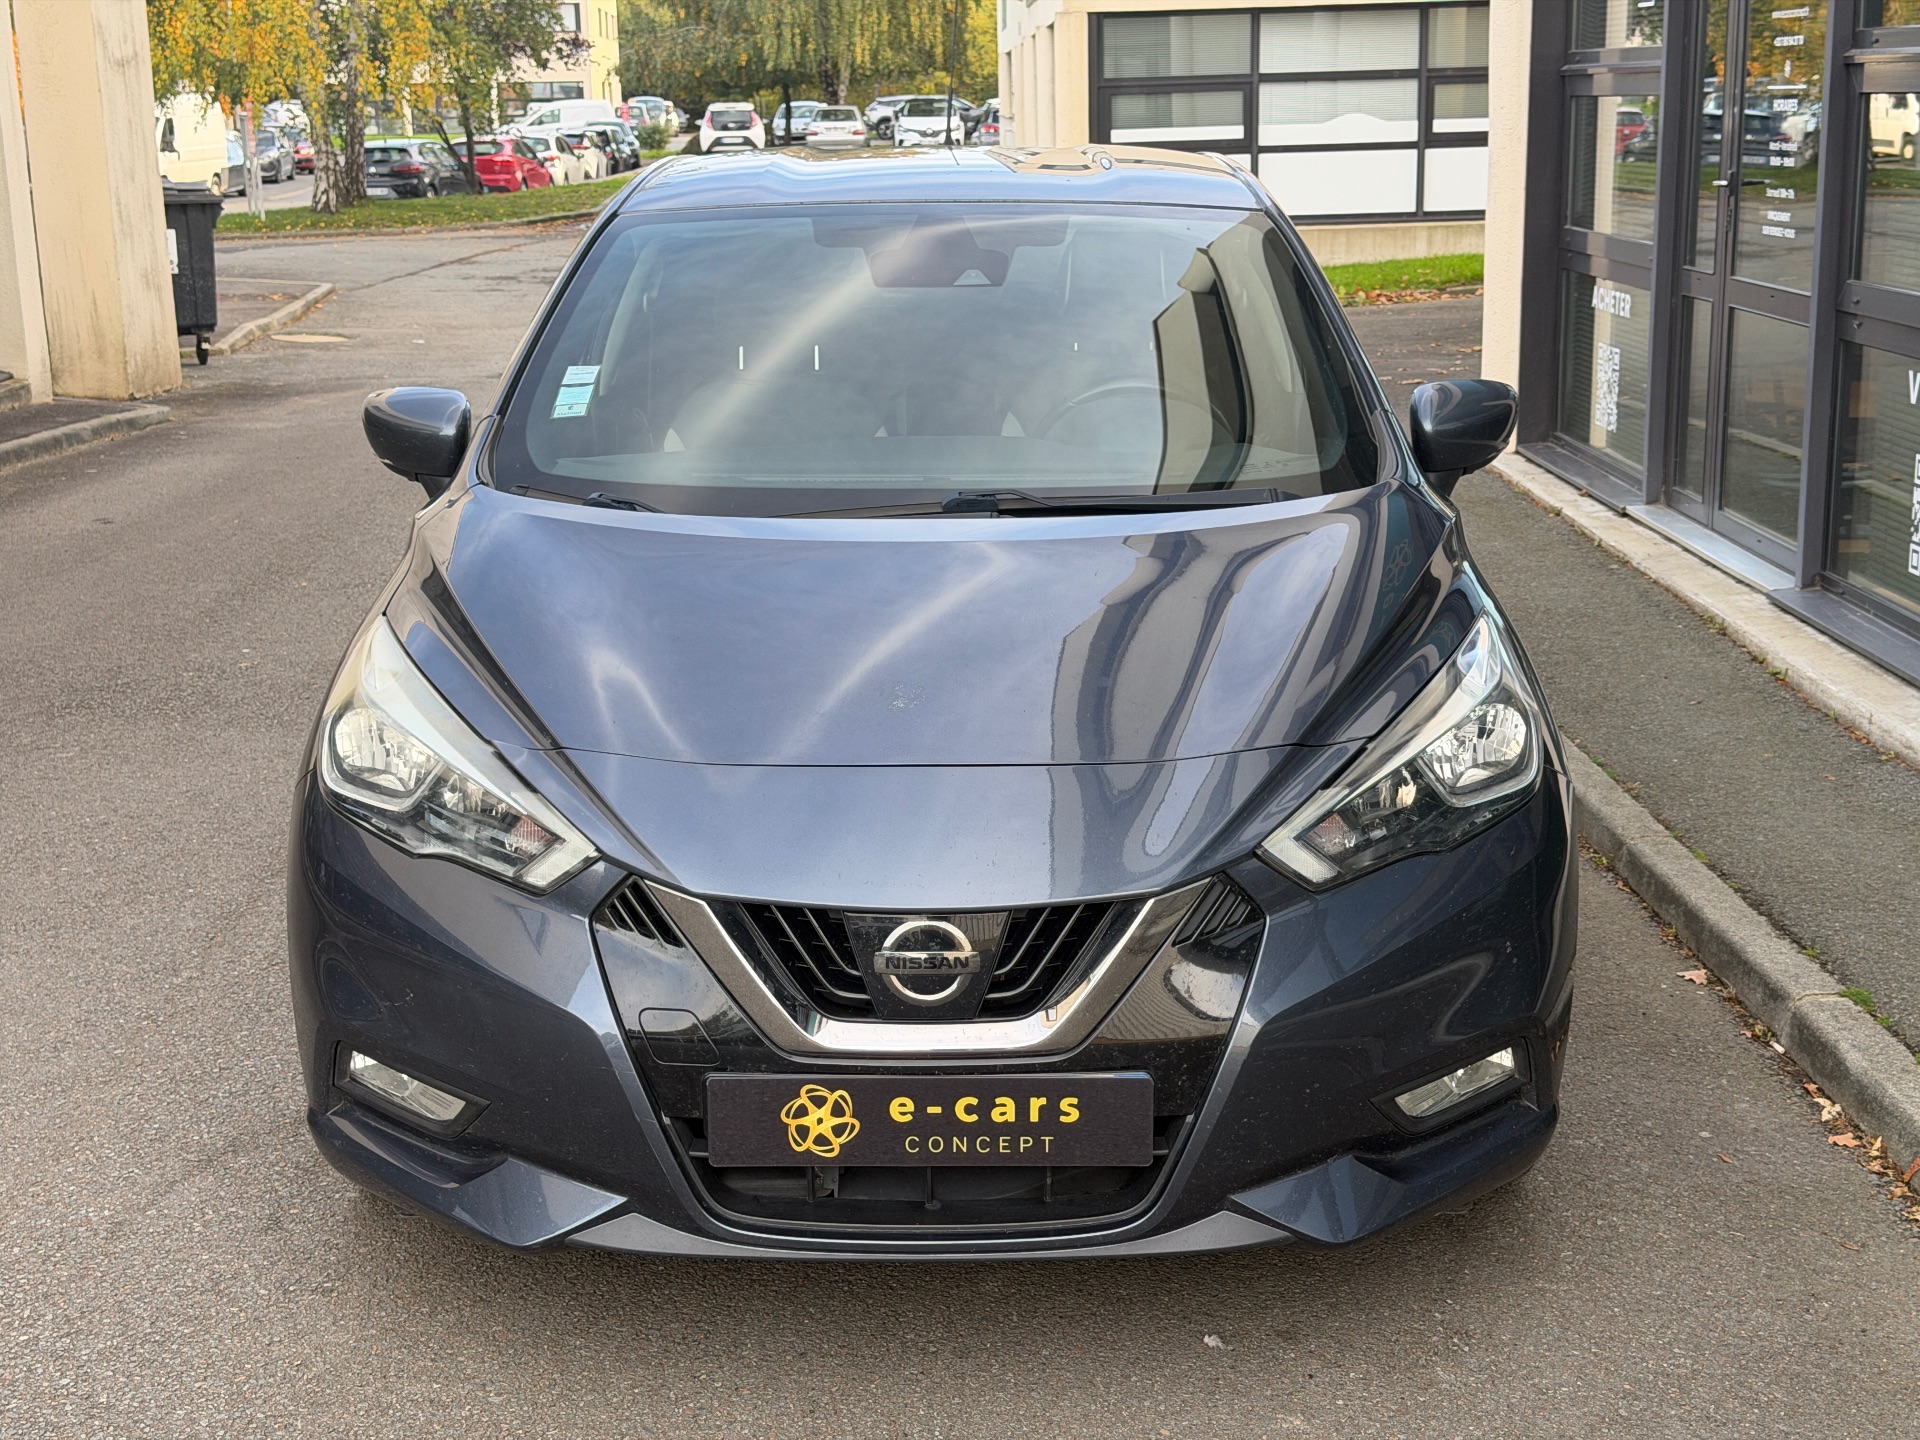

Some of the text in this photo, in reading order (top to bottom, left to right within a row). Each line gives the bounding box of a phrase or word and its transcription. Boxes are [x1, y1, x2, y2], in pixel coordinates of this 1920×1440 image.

[1591, 285, 1631, 318] ACHETER
[885, 956, 970, 969] NISSAN
[889, 1096, 1080, 1123] e-cars
[905, 1136, 1054, 1153] CONCEPT
